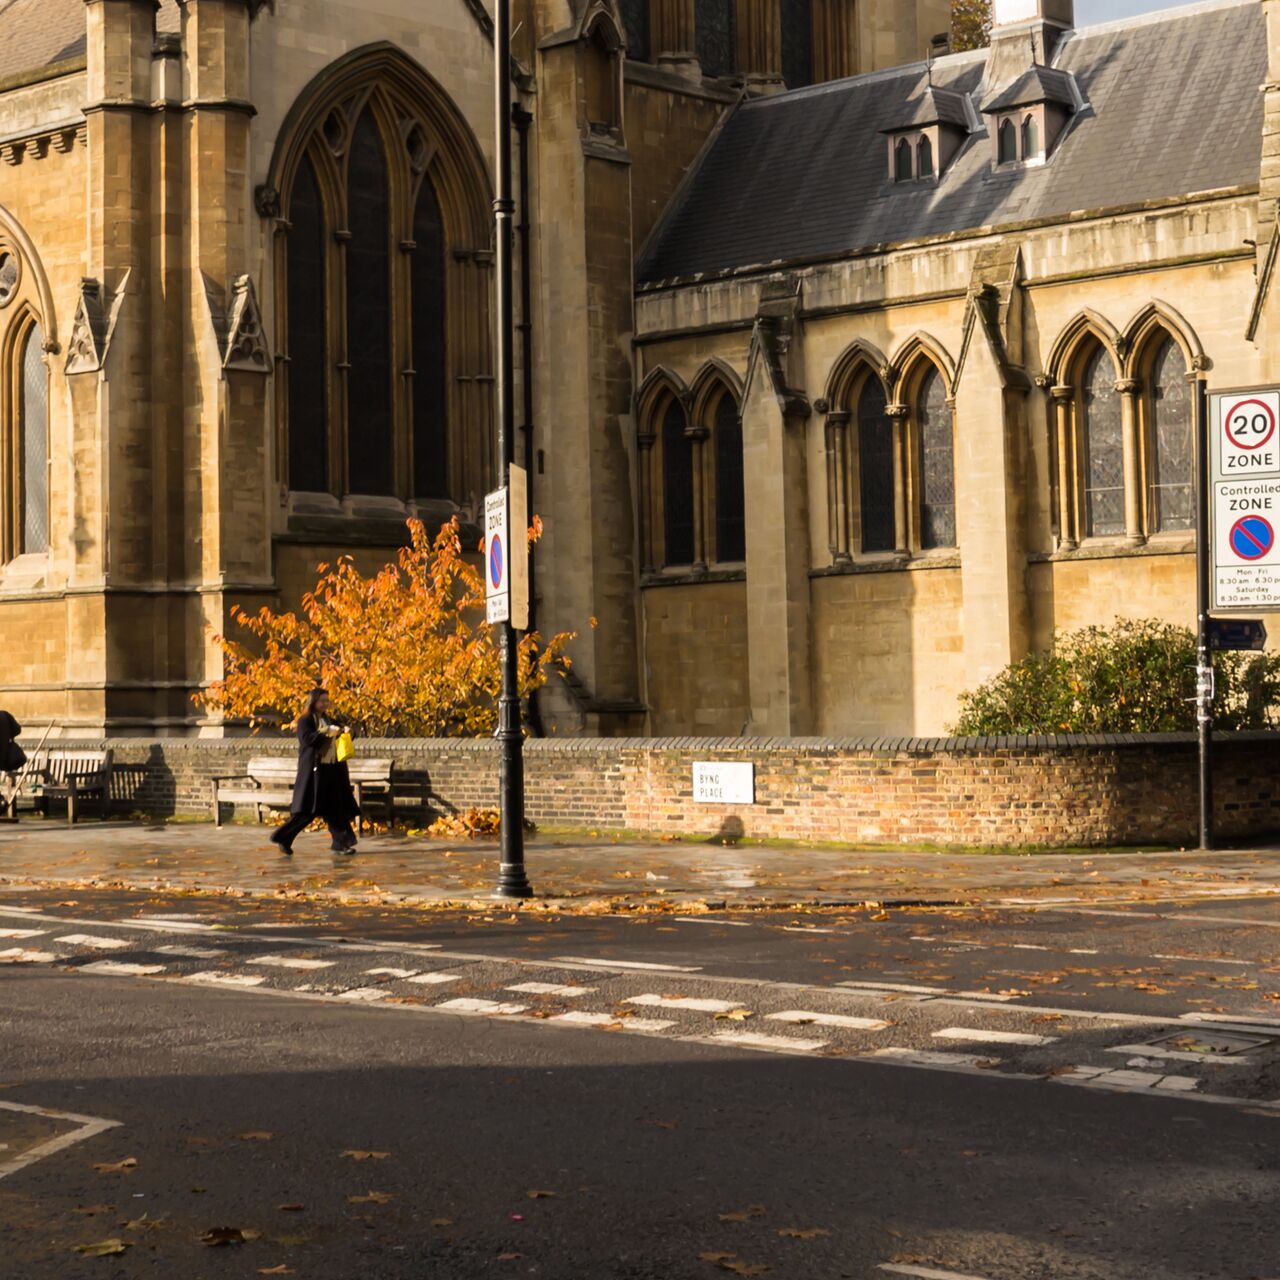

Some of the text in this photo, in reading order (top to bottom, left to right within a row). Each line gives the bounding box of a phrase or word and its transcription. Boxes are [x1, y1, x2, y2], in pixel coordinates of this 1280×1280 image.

[1233, 413, 1268, 435] 20
[1227, 453, 1273, 468] ZONE
[1229, 498, 1273, 511] ZONE
[700, 774, 719, 784] BYNG
[700, 788, 723, 798] PLACE
